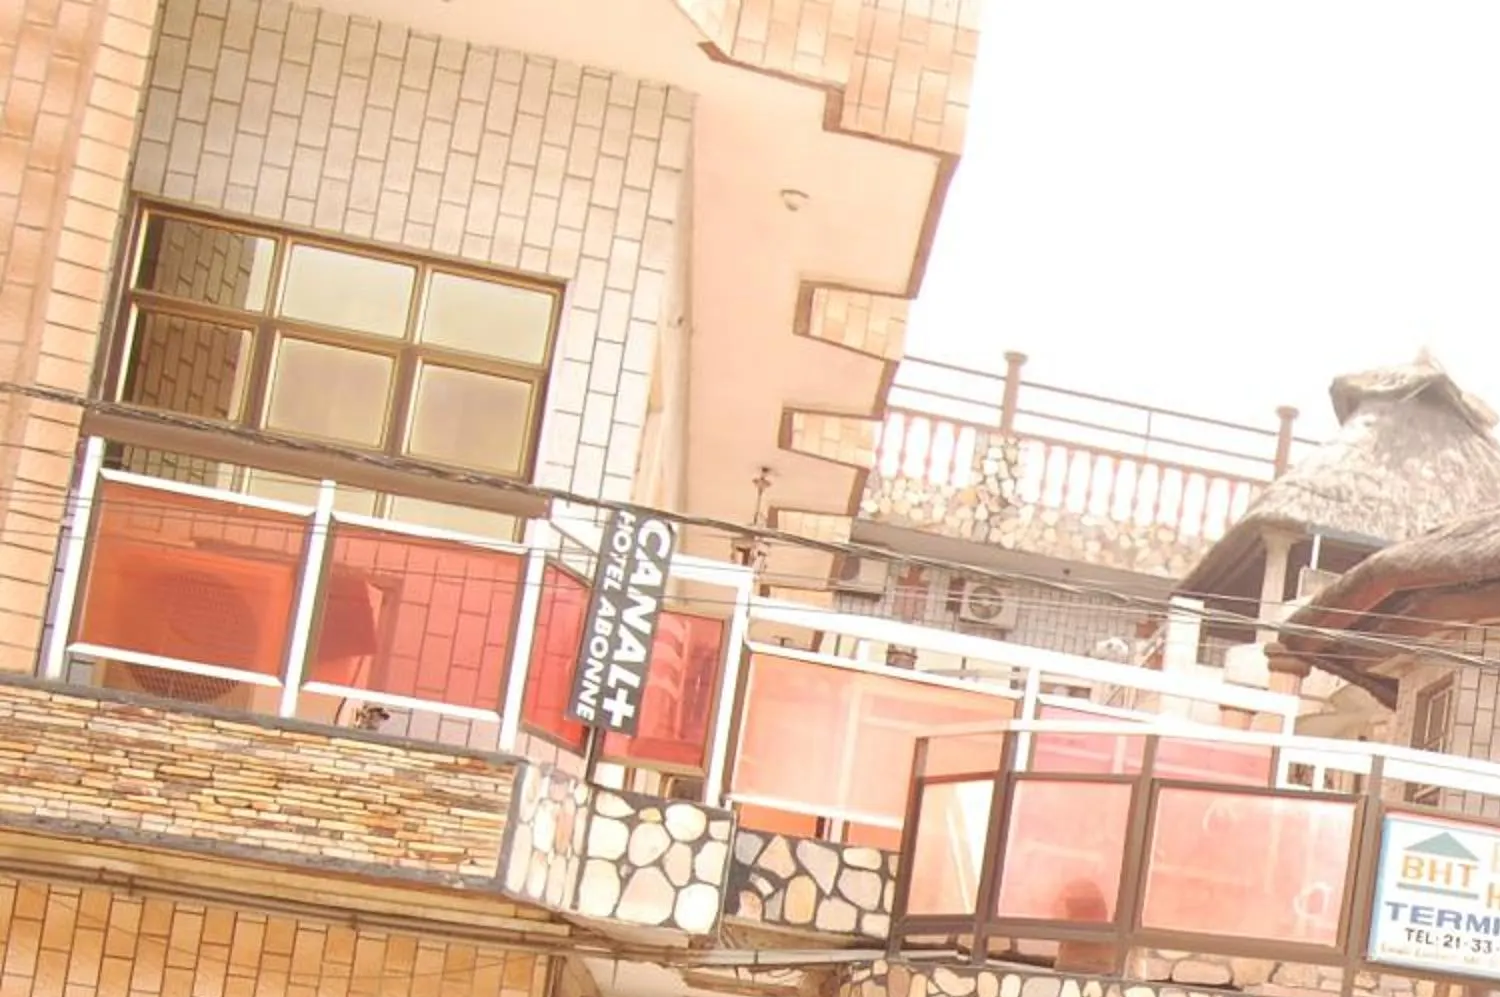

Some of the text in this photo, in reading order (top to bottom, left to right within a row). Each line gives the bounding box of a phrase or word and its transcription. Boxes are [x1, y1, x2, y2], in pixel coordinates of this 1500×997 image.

[576, 510, 636, 721] HOTEL ABONNE
[602, 519, 671, 728] CANAL+
[1401, 855, 1479, 888] BHT
